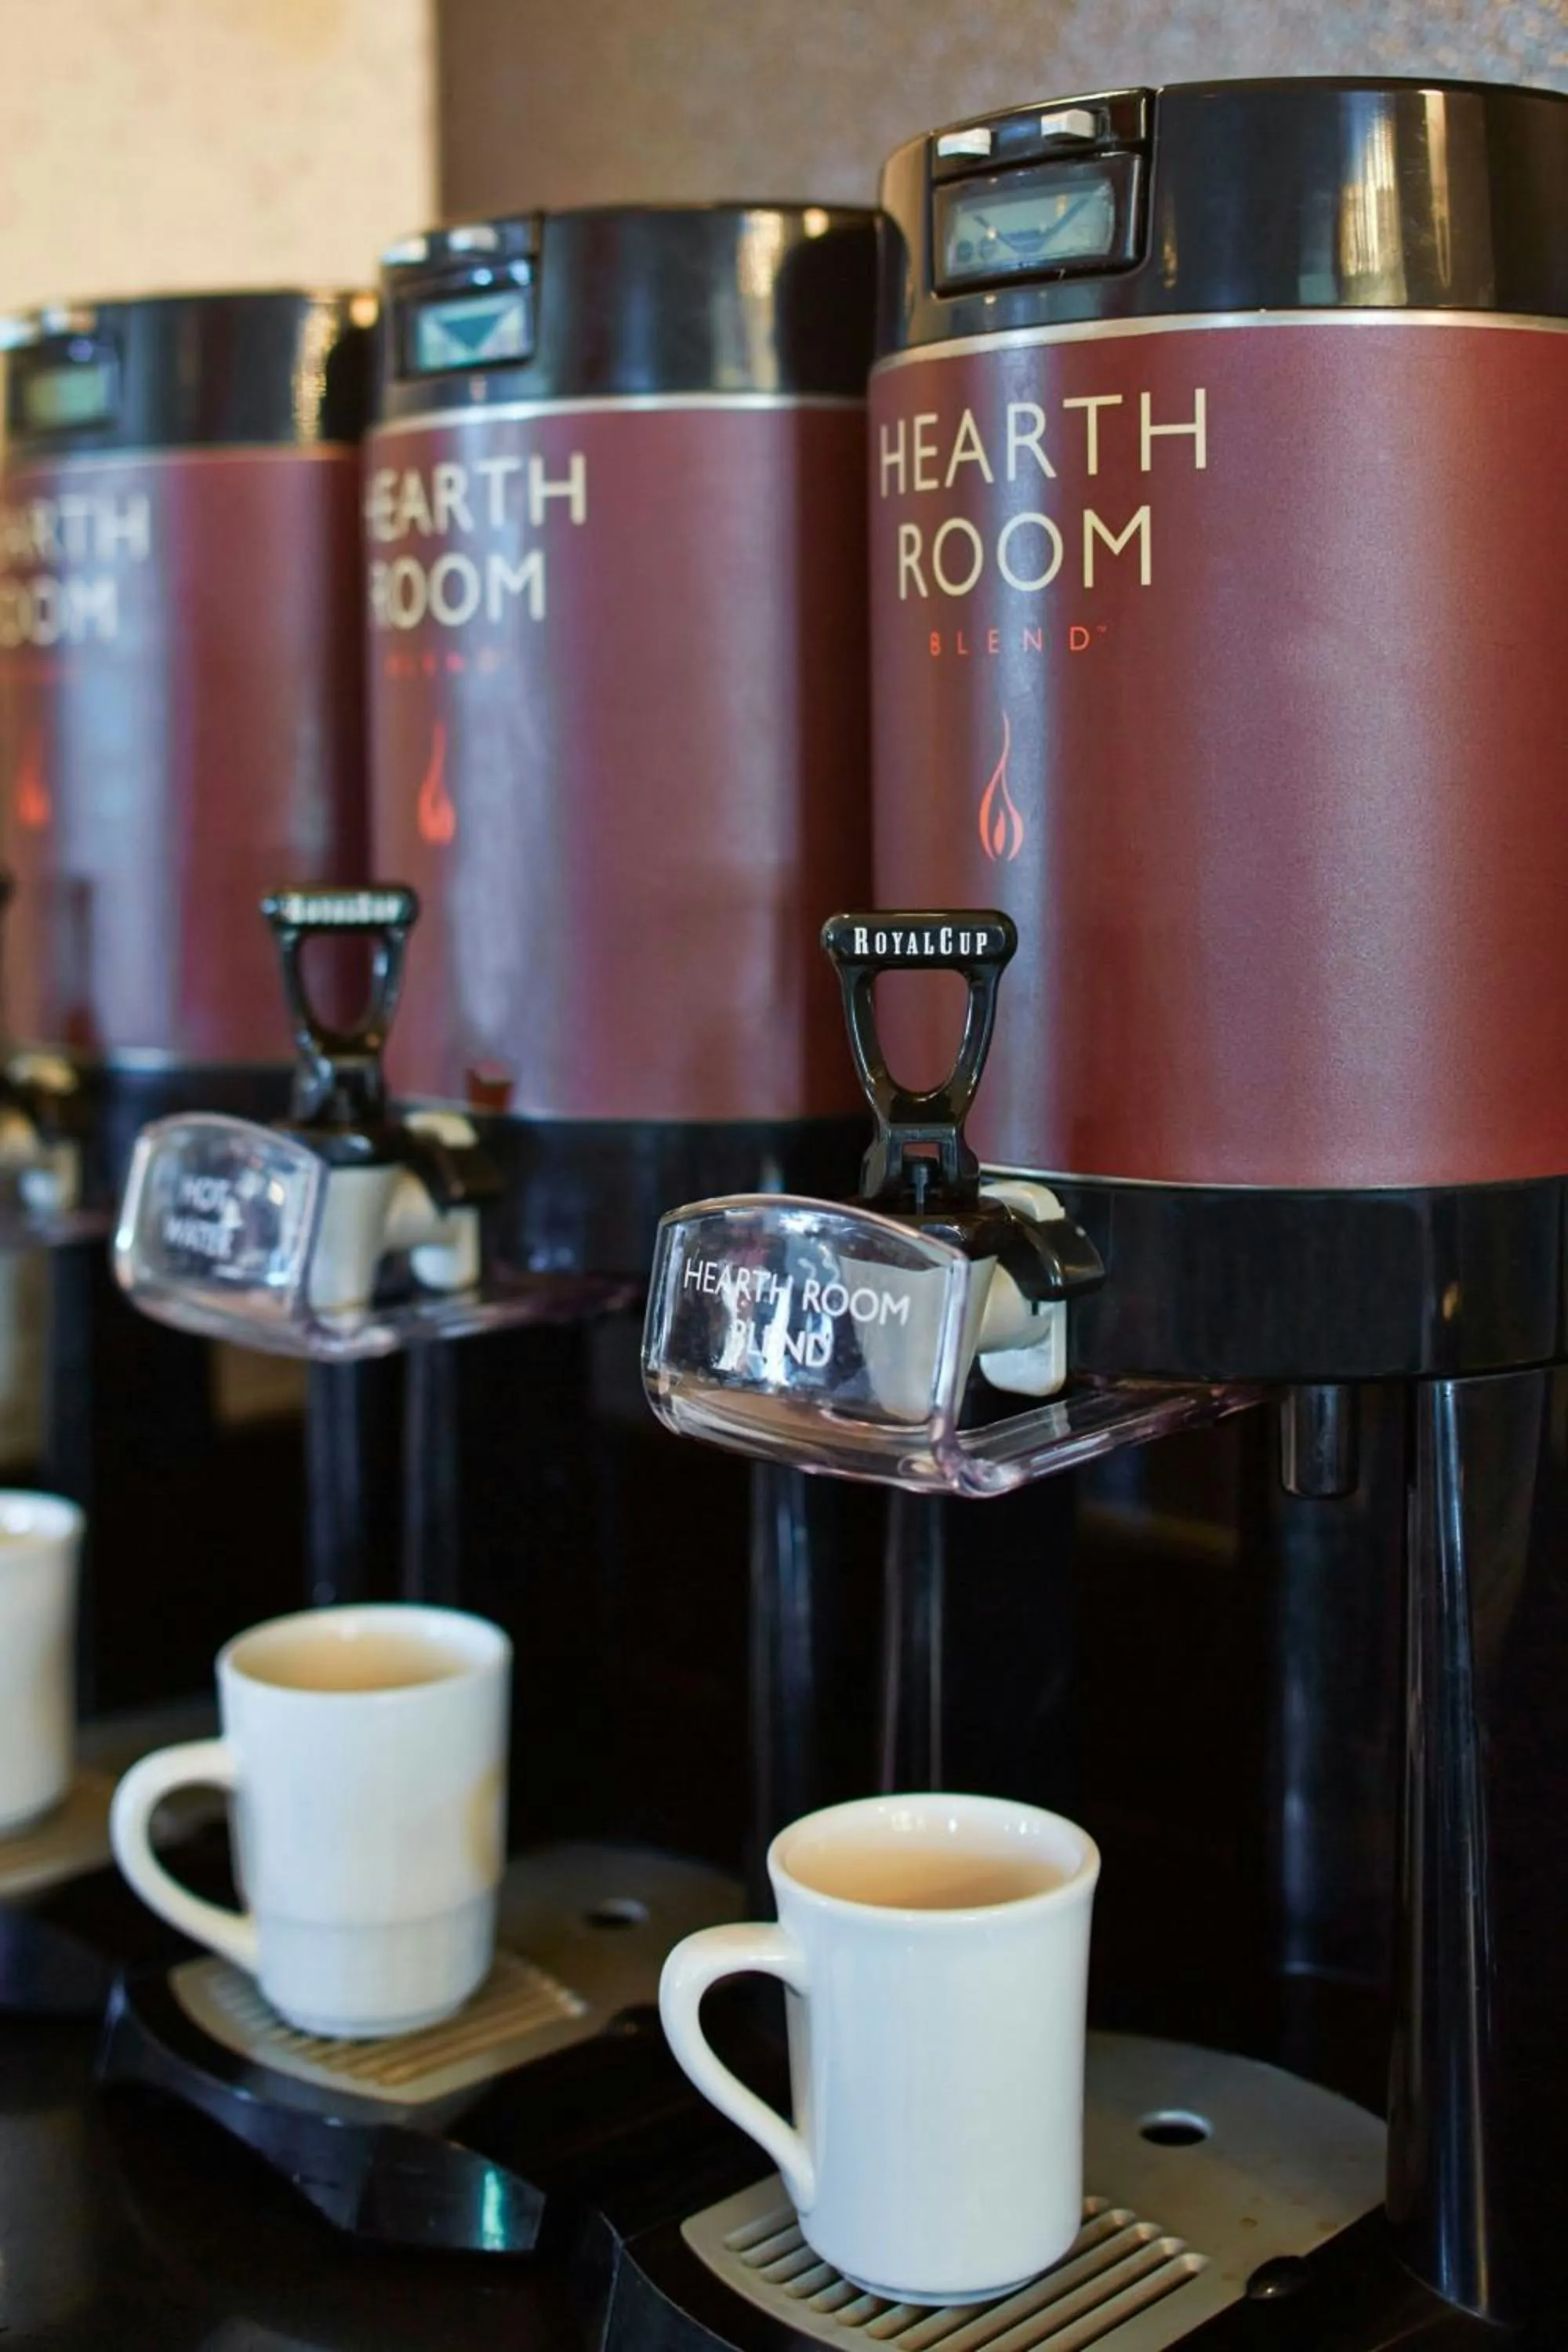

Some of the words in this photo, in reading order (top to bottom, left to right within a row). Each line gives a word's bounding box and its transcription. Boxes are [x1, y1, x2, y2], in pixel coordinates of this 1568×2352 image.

[879, 387, 1207, 499] HEARTH
[898, 504, 1152, 601] ROOM
[683, 1258, 793, 1305] HEARTH
[801, 1279, 911, 1327] ROOM
